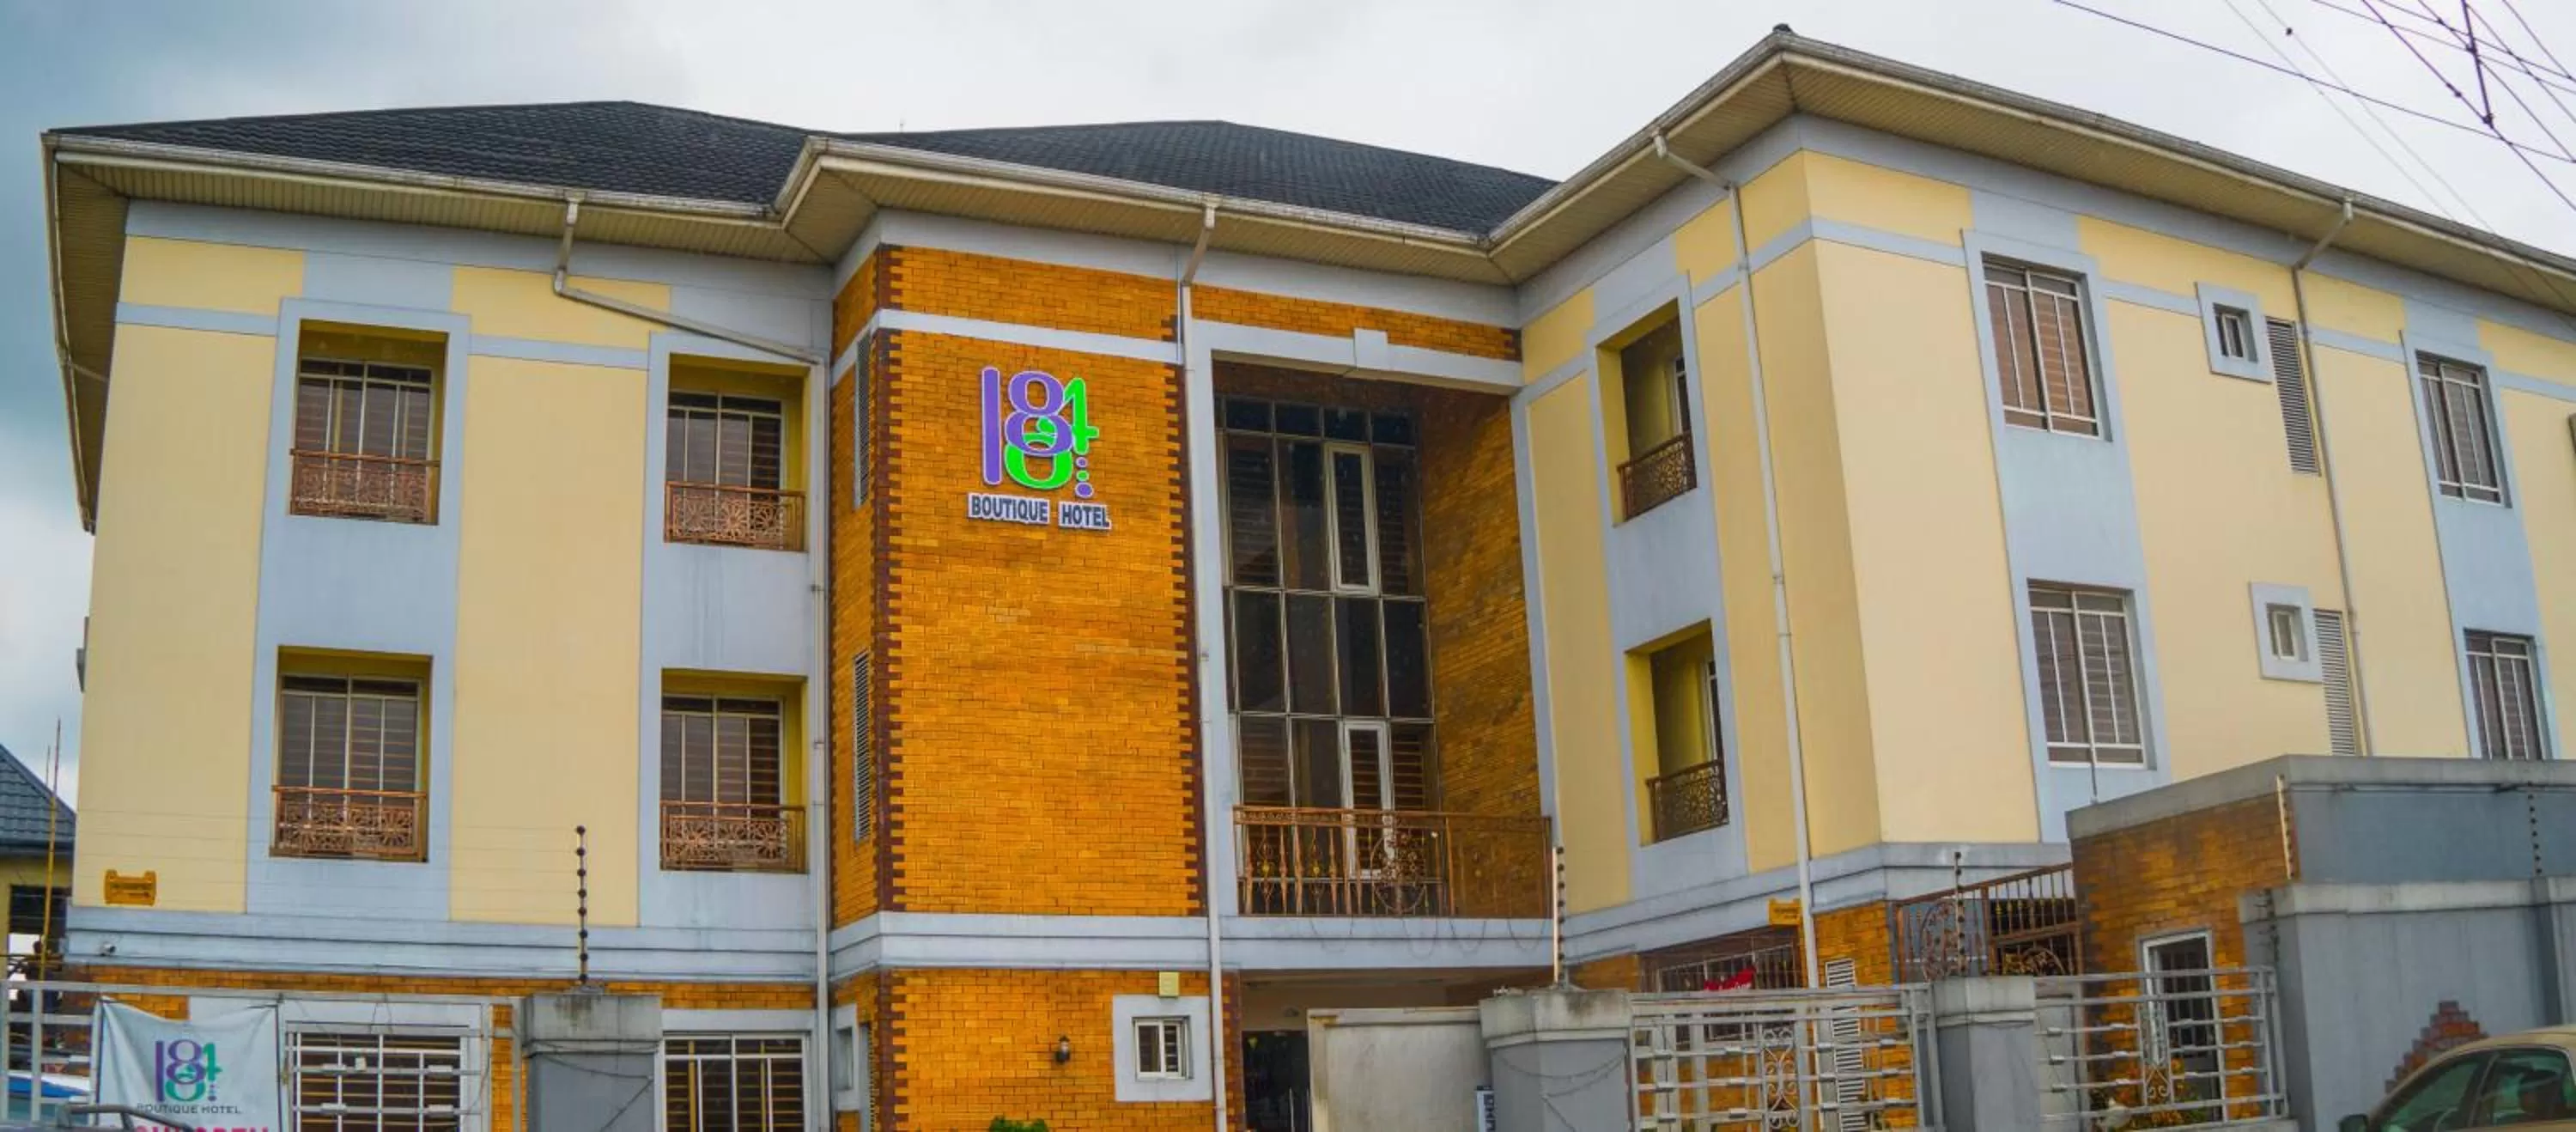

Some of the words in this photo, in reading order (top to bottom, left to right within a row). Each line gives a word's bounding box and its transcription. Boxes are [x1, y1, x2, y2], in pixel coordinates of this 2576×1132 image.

[970, 496, 1048, 522] BOUTIQUE
[1060, 504, 1110, 527] HOTEL
[202, 1105, 241, 1114] HOTEL
